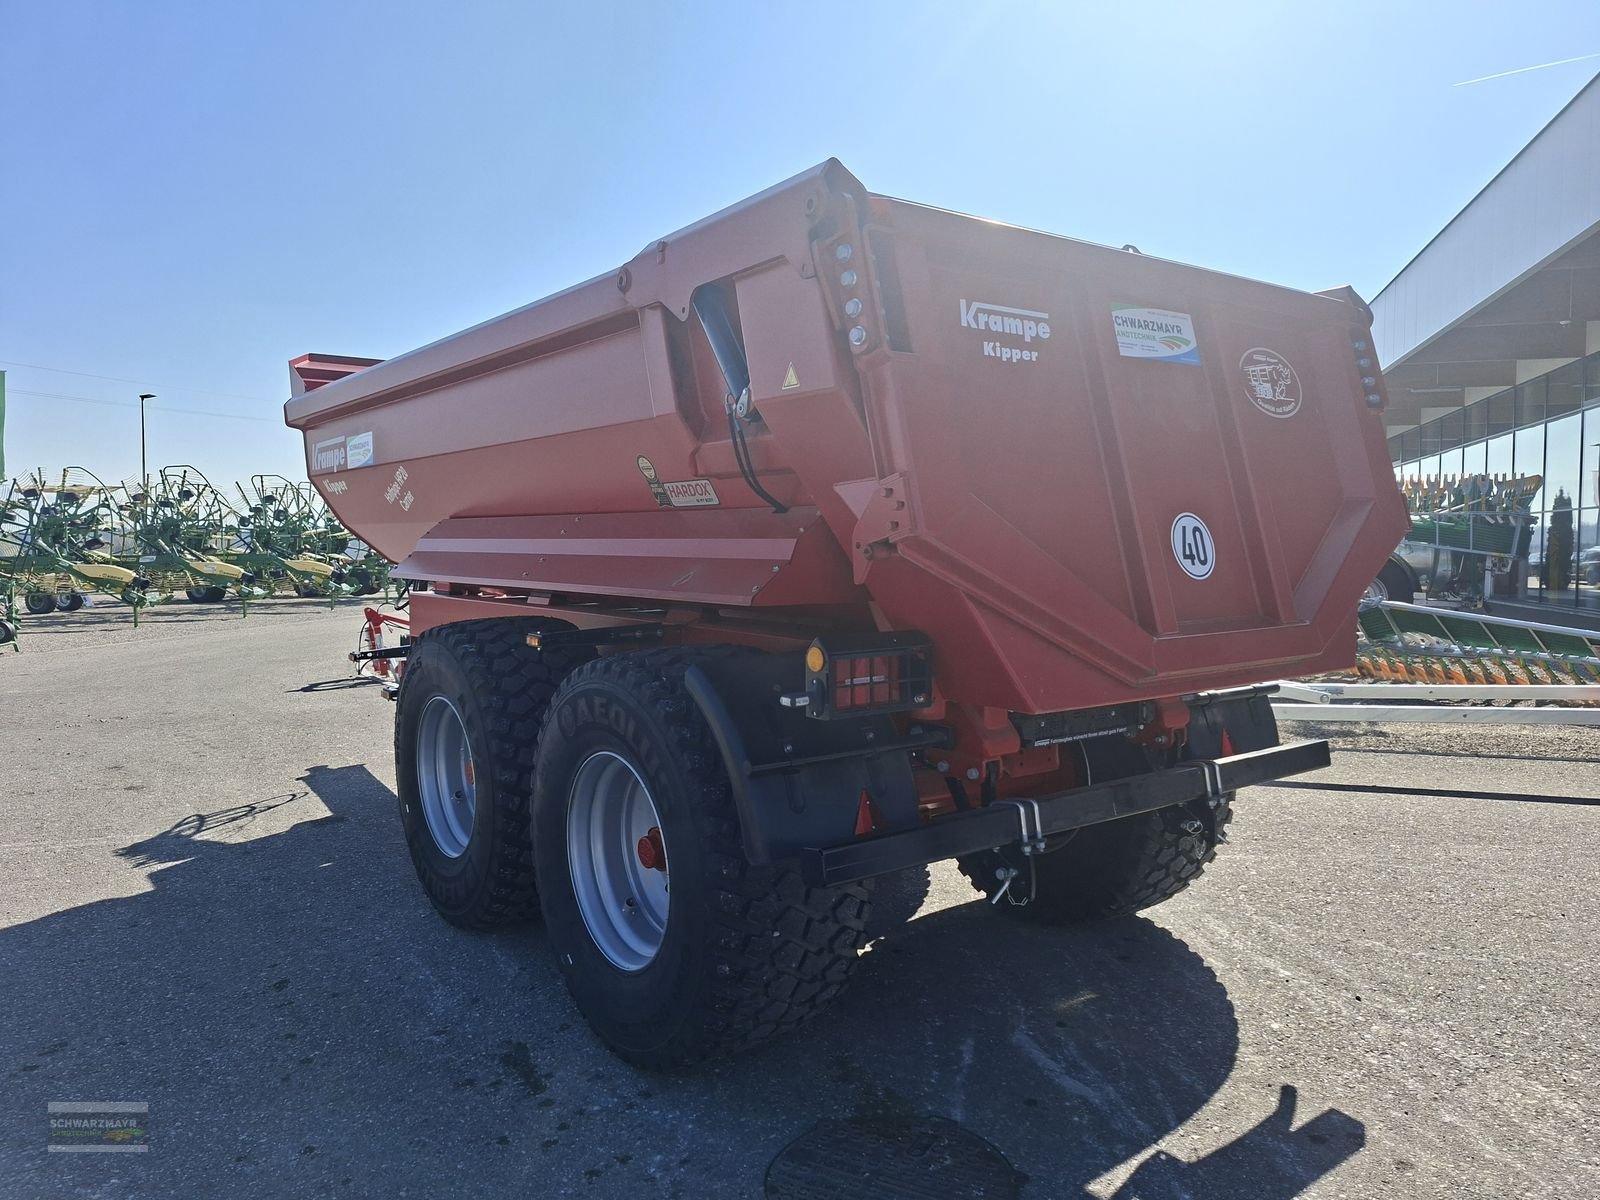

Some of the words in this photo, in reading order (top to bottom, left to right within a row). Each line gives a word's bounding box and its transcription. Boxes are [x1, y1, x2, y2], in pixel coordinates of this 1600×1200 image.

[960, 299, 1051, 342] Krampe
[1114, 315, 1183, 335] CHWARZMAYR
[983, 341, 1039, 362] Kipper
[312, 434, 346, 473] Krampe
[322, 479, 348, 495] Kipper
[667, 482, 711, 498] HARDOX
[1182, 525, 1208, 566] 40
